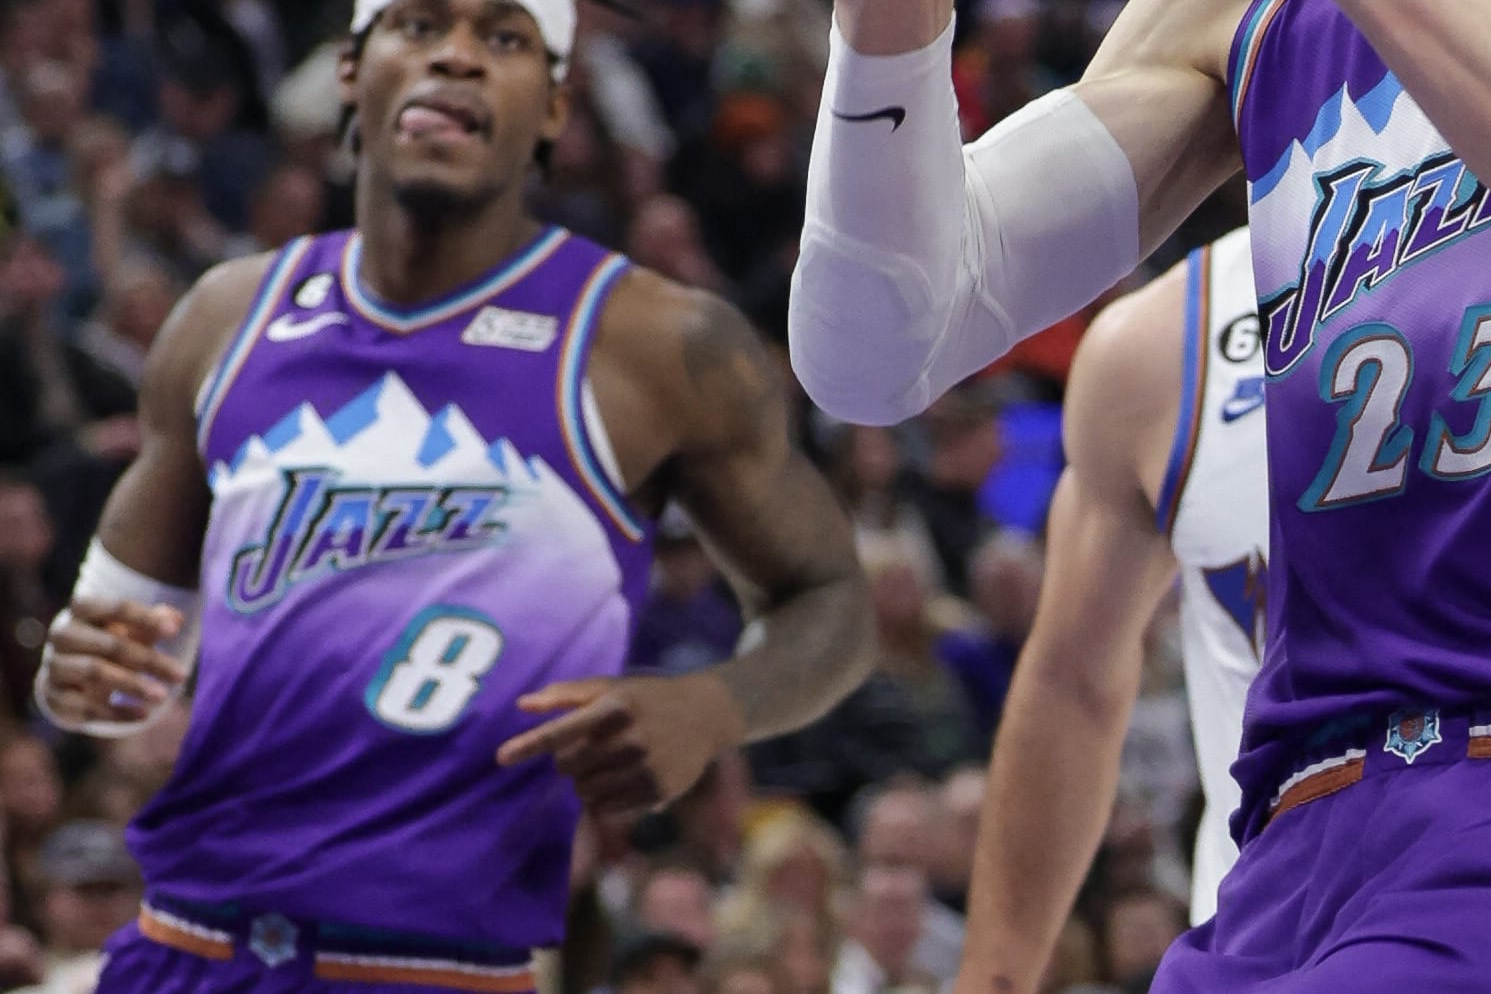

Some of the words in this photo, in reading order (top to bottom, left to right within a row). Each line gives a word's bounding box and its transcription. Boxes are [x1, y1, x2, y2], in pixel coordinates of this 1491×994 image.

[1219, 311, 1261, 363] 6
[228, 465, 508, 615] JAZZ
[365, 605, 504, 735] 8
